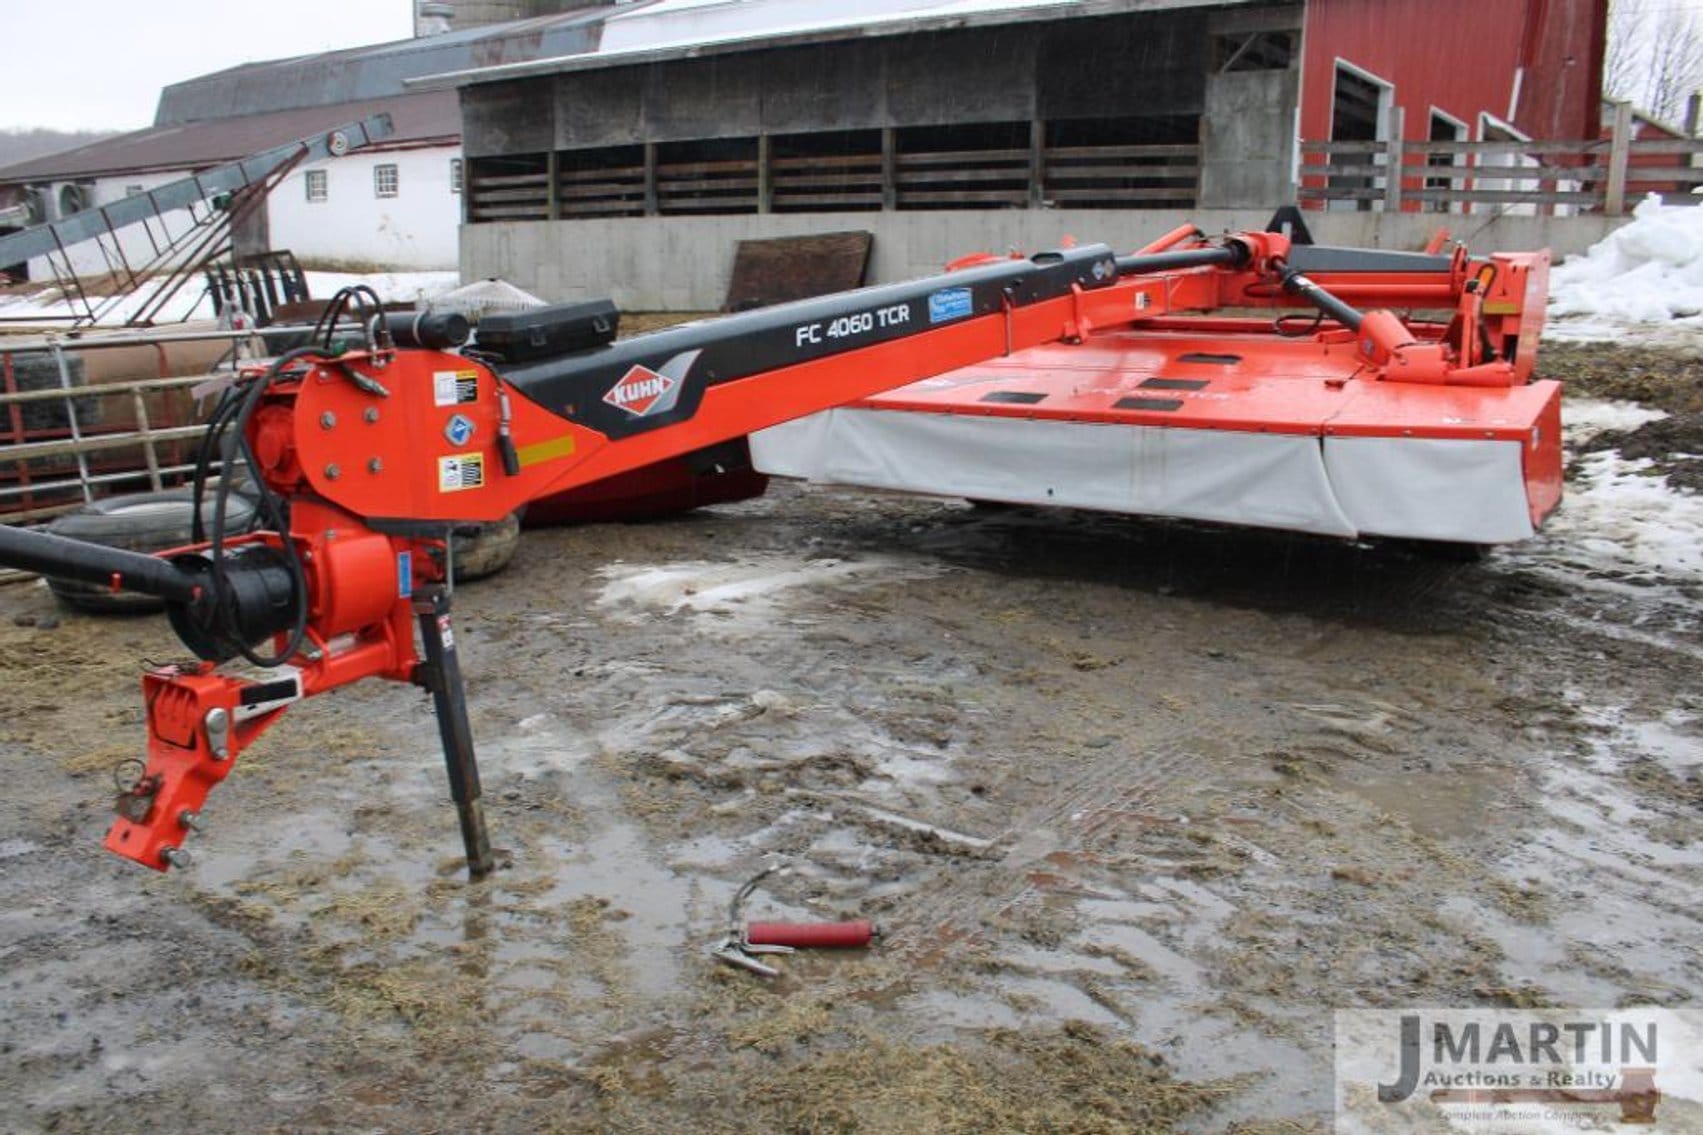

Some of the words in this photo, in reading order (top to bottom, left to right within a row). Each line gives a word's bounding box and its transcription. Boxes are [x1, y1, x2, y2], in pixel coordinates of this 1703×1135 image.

[796, 323, 822, 347] FC
[827, 312, 873, 338] 4060
[877, 304, 910, 327] TCR
[613, 376, 665, 404] KUHN
